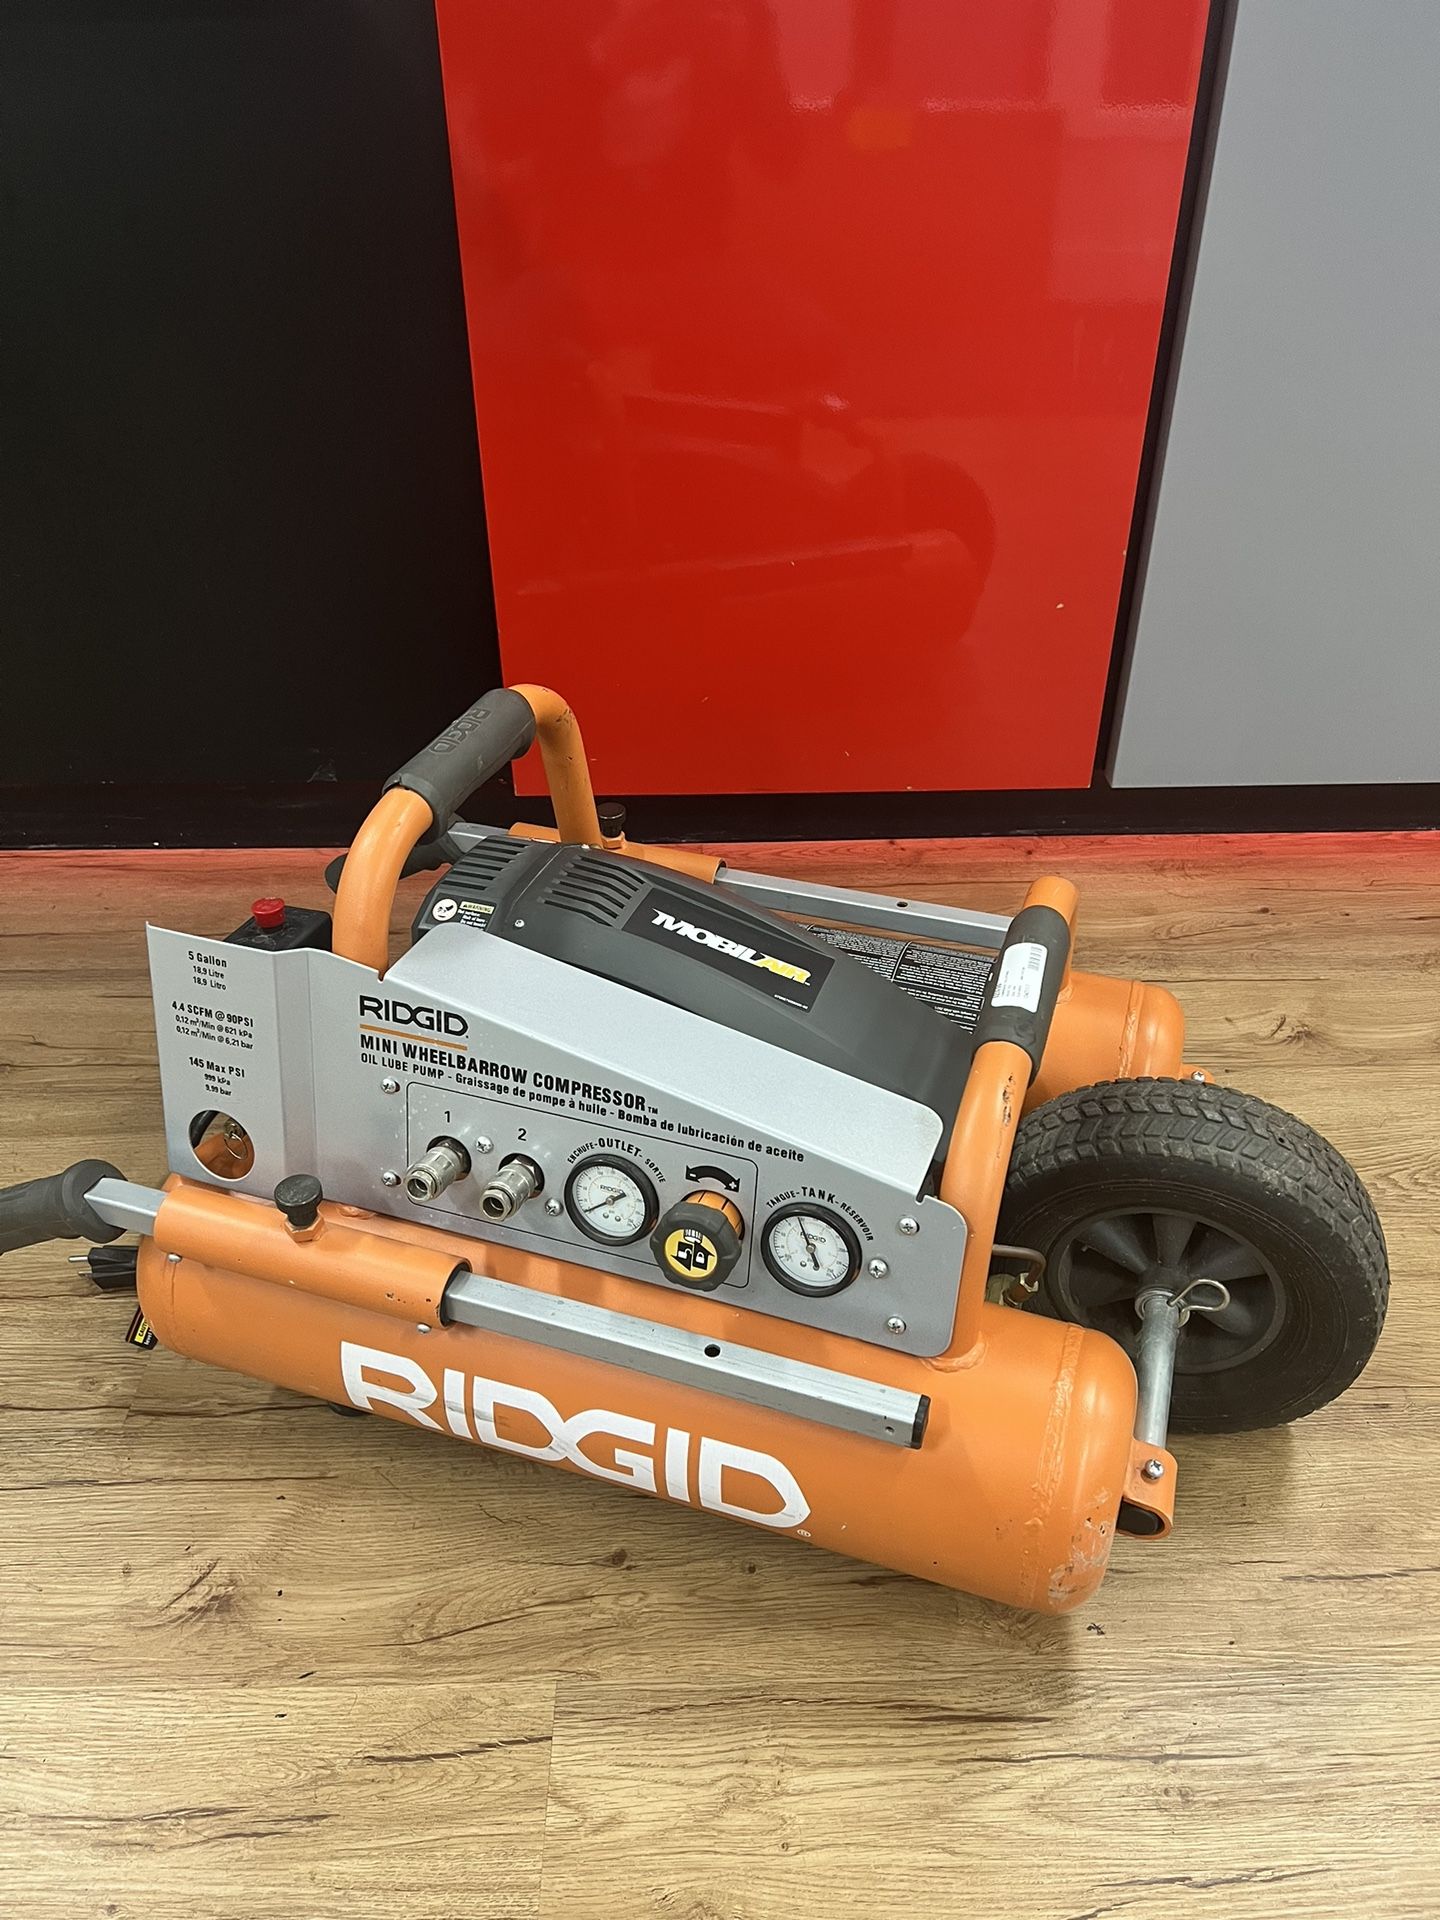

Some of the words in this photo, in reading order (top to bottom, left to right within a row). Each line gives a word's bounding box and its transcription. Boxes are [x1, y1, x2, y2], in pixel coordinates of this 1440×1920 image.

[652, 907, 811, 984] MOBILAIR
[188, 950, 195, 961] 5
[196, 952, 227, 968] Gallon
[208, 968, 225, 980] Litre
[210, 979, 227, 991] Litro
[187, 1004, 213, 1019] SCFM
[214, 1010, 225, 1022] @
[226, 1013, 254, 1028] 90PSI
[359, 994, 468, 1037] RIDGID
[216, 1024, 224, 1033] @
[224, 1026, 237, 1036] 621
[238, 1029, 253, 1039] kPa
[217, 1035, 225, 1043] @
[240, 1040, 254, 1050] bar
[188, 1056, 205, 1068] 145
[206, 1060, 226, 1074] Max
[228, 1065, 245, 1078] PSI
[360, 1033, 398, 1055] MINI
[402, 1042, 528, 1084] WHEELBARROW
[533, 1072, 646, 1112] COMPRESSOR
[217, 1075, 231, 1086] kPa
[219, 1086, 232, 1097] bar
[360, 1052, 378, 1065] OIL
[381, 1056, 408, 1072] LUBE
[412, 1064, 445, 1080] PUMP
[455, 1072, 509, 1095] Graissage
[512, 1086, 526, 1098] de
[528, 1091, 566, 1108] pompe
[568, 1097, 576, 1109] à
[578, 1100, 607, 1116] huile
[617, 1109, 657, 1128] Bomba
[660, 1119, 674, 1132] de
[677, 1122, 745, 1149] lubricación
[747, 1140, 763, 1152] de
[765, 1147, 805, 1162] aceite
[443, 1109, 451, 1123] 1
[516, 1127, 527, 1142] 2
[340, 1340, 812, 1529] RIDGID
